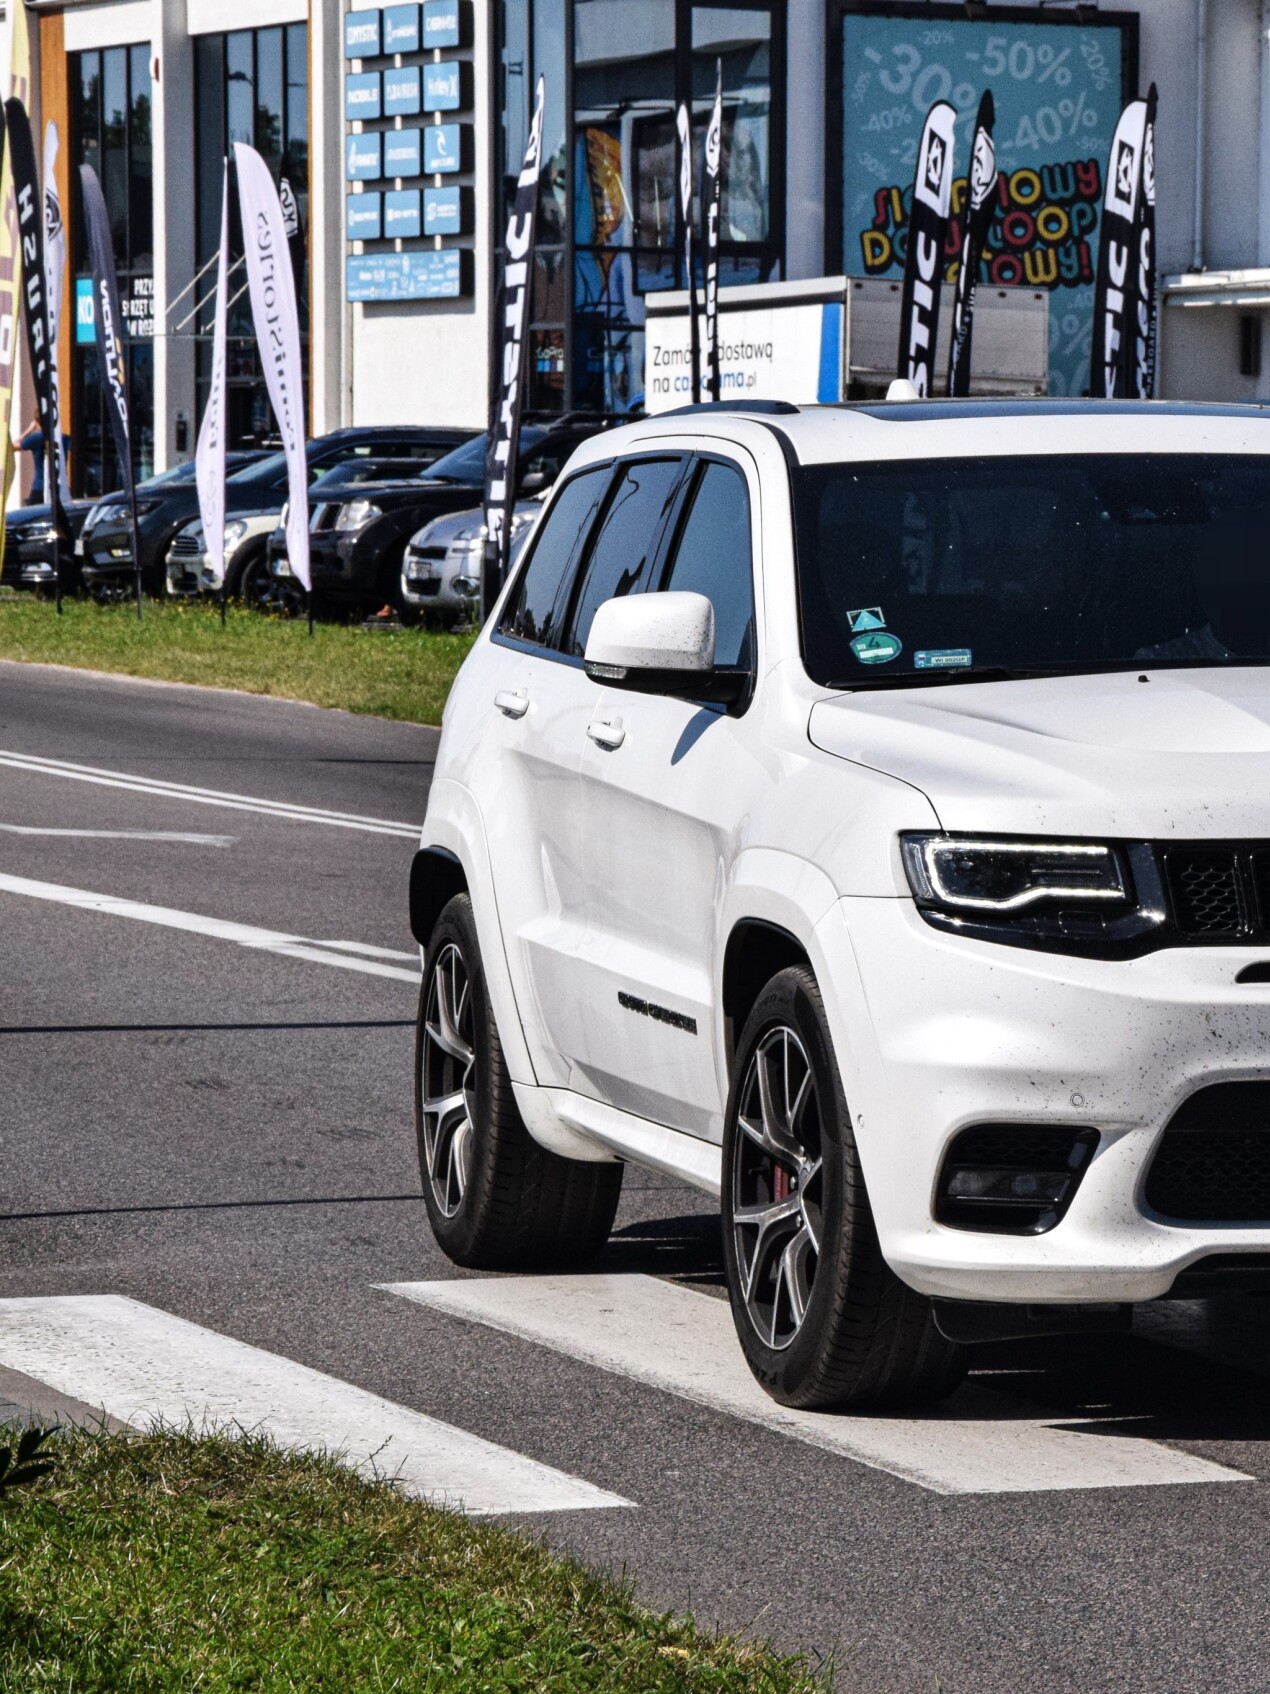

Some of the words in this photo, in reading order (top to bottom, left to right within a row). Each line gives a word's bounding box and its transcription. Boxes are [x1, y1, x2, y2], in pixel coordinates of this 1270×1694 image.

[966, 36, 1072, 87] -50%
[1001, 91, 1098, 151] -40%
[653, 376, 669, 393] na
[867, 636, 881, 649] 4
